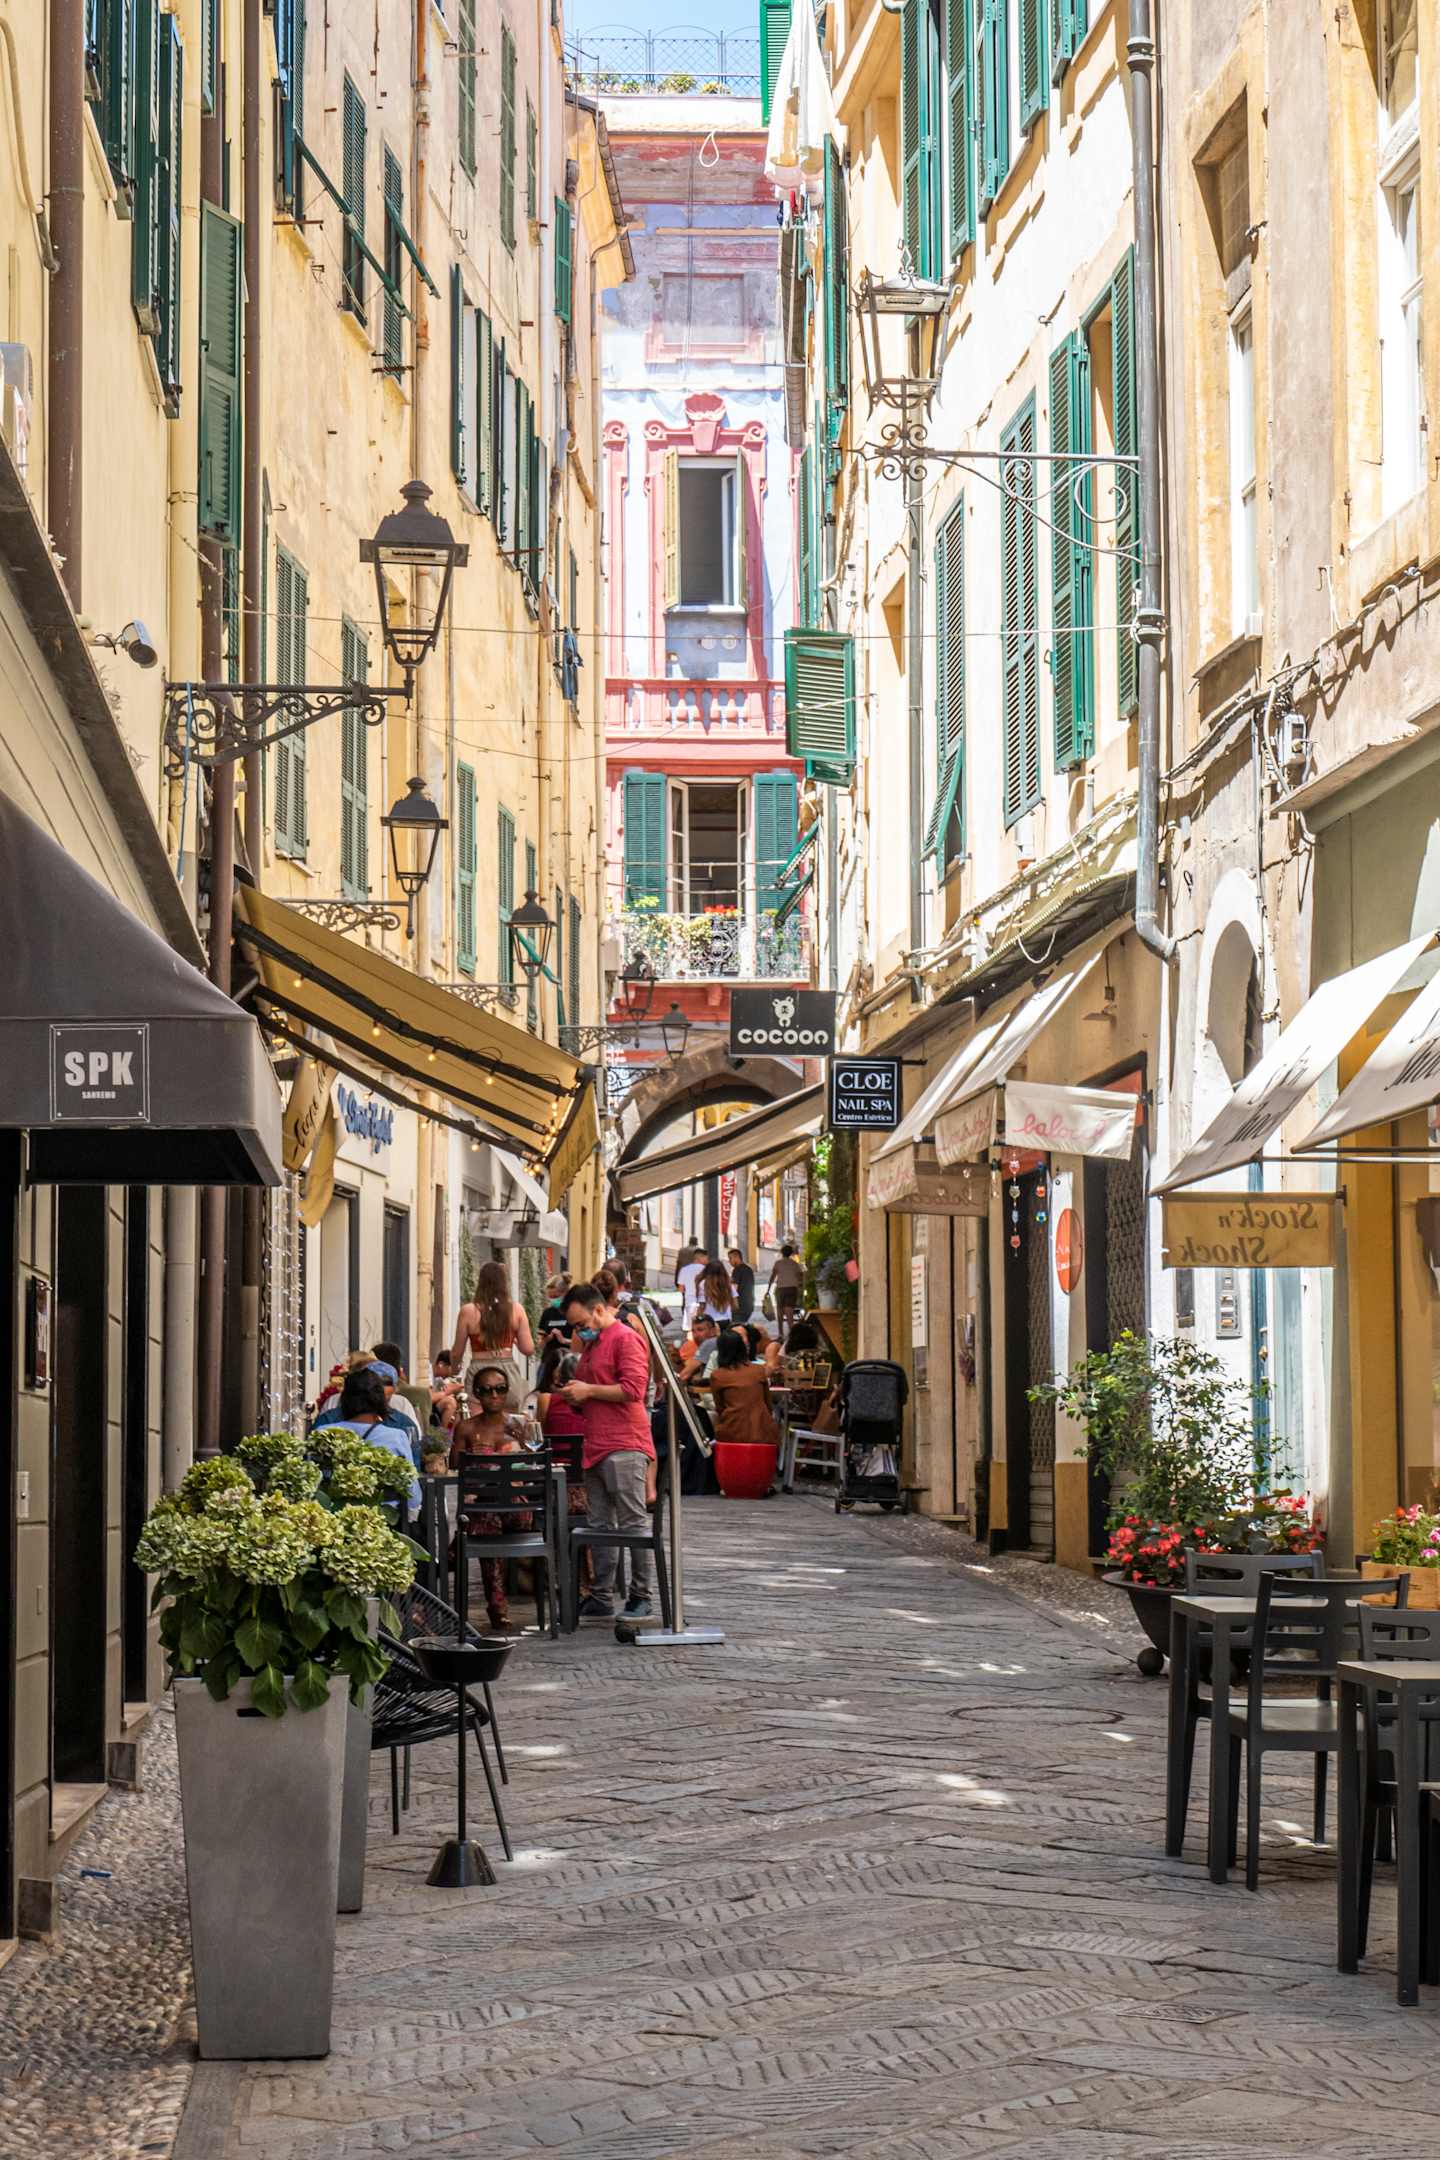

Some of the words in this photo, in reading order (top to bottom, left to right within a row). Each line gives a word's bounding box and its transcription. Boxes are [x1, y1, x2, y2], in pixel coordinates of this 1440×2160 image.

[65, 1051, 134, 1086] SPK
[838, 1072, 893, 1090] CLOE
[838, 1099, 868, 1111] NAIL
[870, 1099, 893, 1111] SPA
